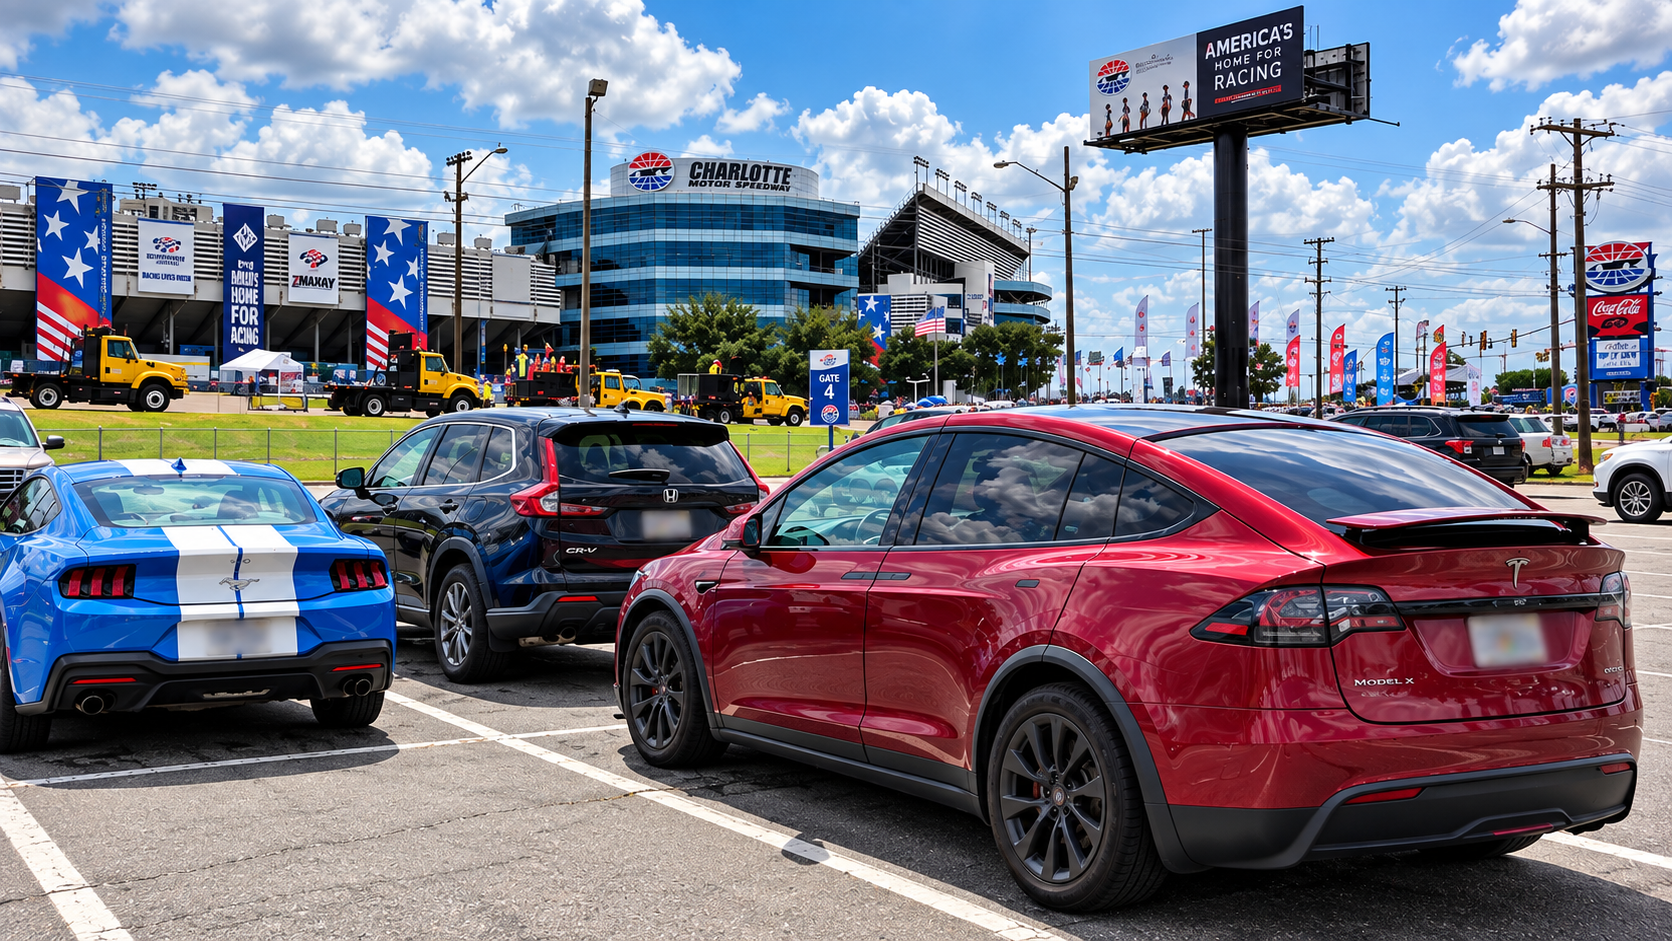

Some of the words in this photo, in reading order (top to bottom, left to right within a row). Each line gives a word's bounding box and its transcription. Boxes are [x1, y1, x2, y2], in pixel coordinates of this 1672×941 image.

[1205, 23, 1293, 59] AMERICA'S
[1215, 54, 1250, 71] HOME
[1257, 46, 1281, 61] FOR
[1214, 61, 1281, 91] RACING
[689, 161, 792, 185] CHARLOTTE
[688, 180, 731, 188] MOTOR
[734, 181, 791, 192] SPEEDWAY
[231, 305, 259, 325] FOR
[819, 374, 840, 383] GATE
[824, 384, 835, 399] 4
[1354, 678, 1403, 687] MODEL
